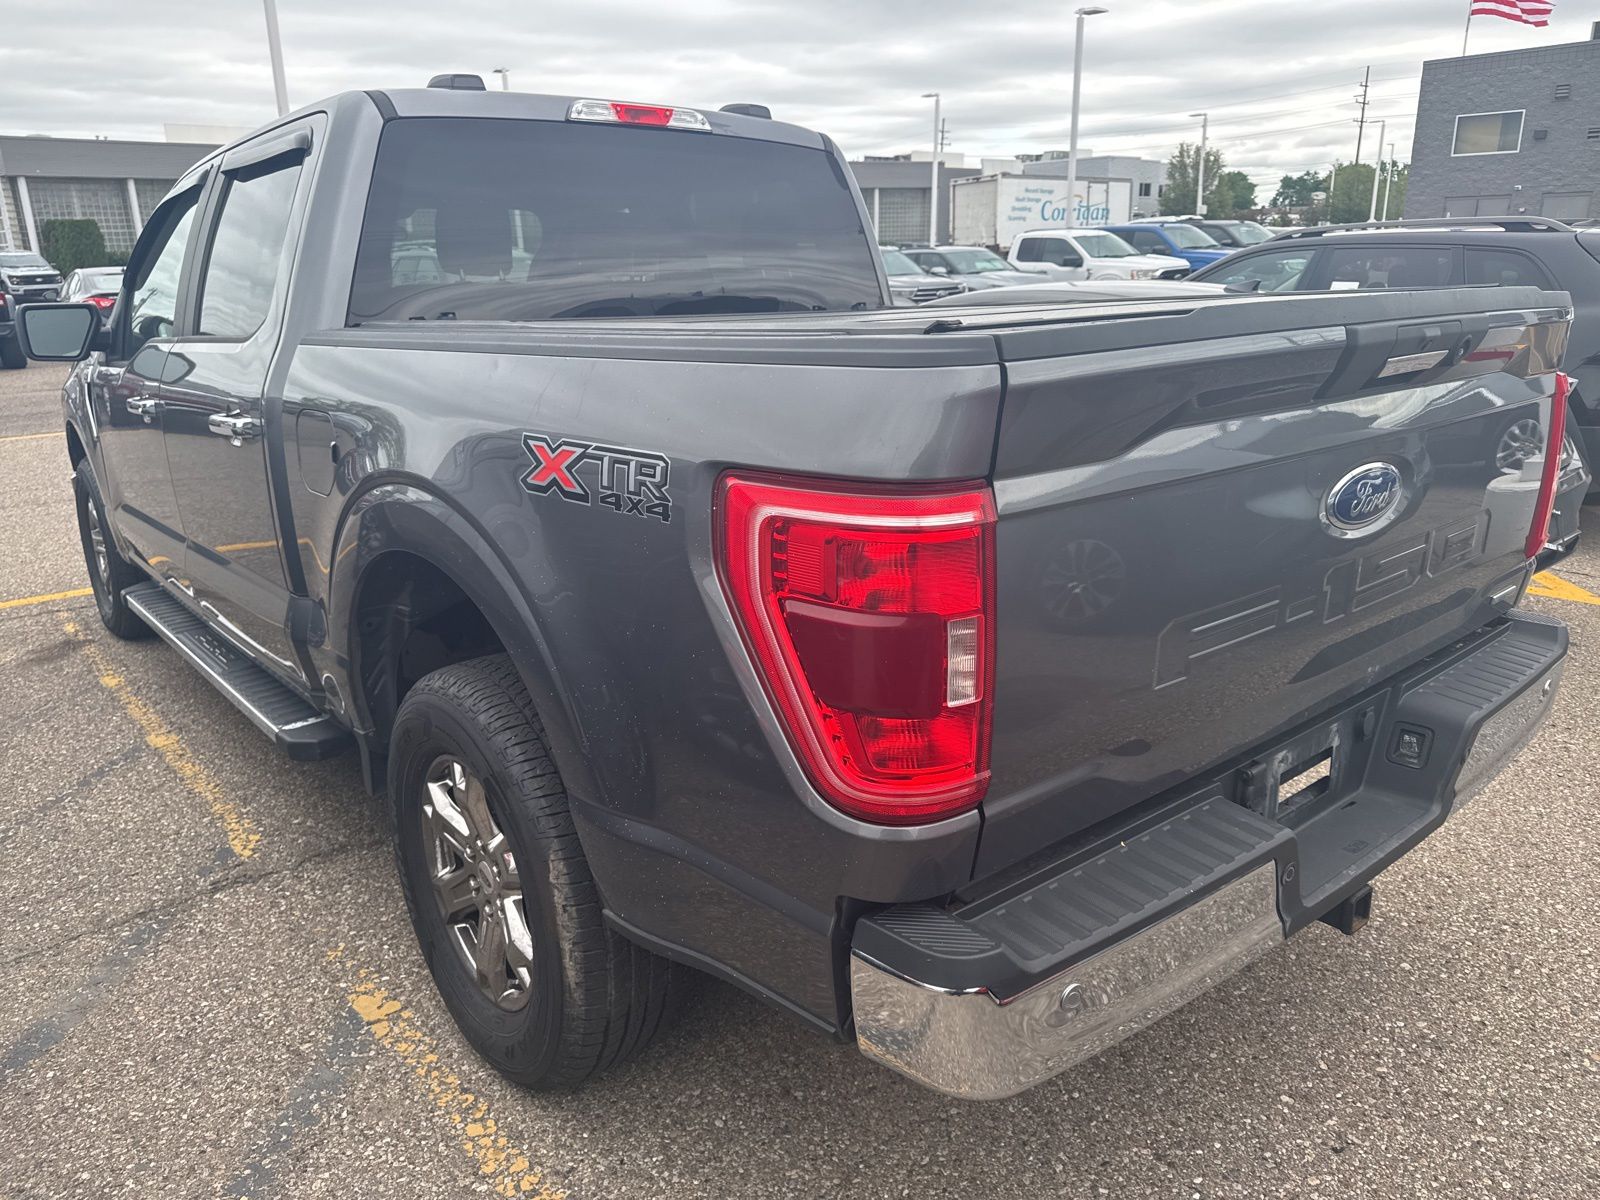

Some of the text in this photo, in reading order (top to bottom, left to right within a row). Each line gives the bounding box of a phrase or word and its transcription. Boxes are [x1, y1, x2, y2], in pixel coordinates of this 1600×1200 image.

[519, 432, 673, 506] XTR
[1351, 477, 1394, 517] Ford
[1153, 508, 1492, 691] F-150
